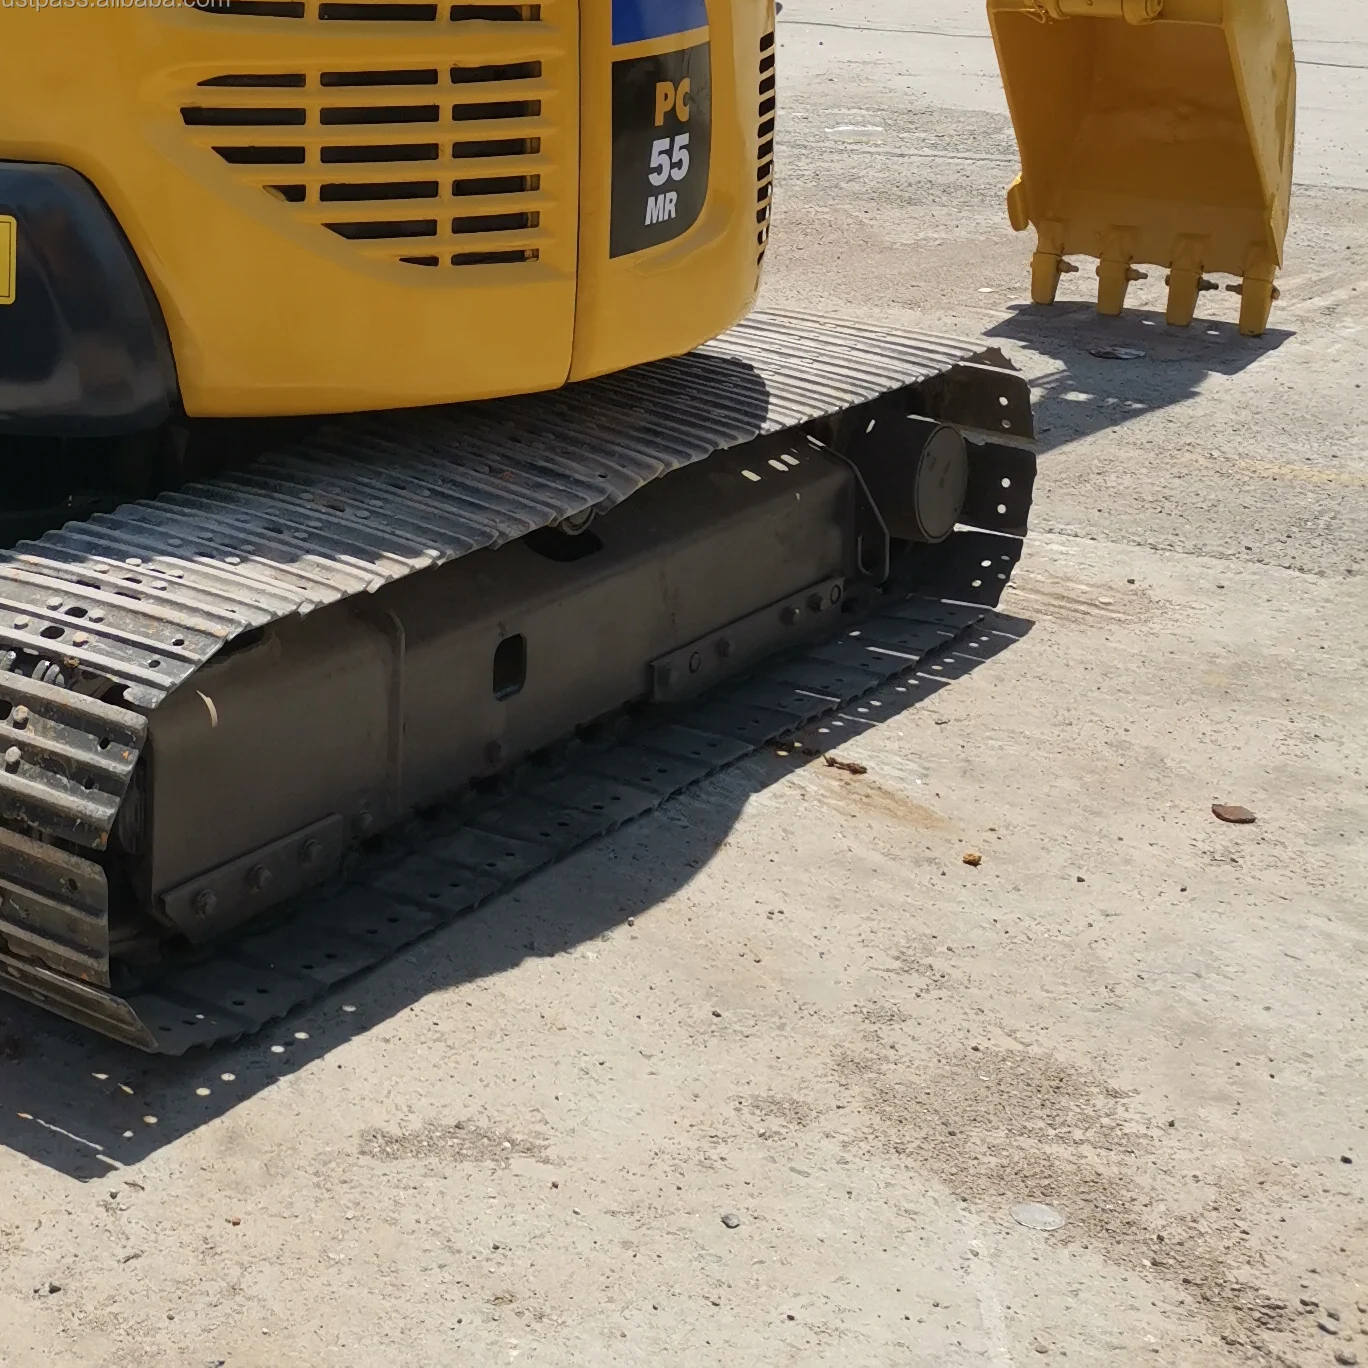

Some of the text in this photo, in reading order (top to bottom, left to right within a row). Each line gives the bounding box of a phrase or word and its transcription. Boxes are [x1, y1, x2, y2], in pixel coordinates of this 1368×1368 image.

[654, 77, 691, 127] PC
[648, 132, 690, 186] 55
[644, 191, 678, 226] MR
